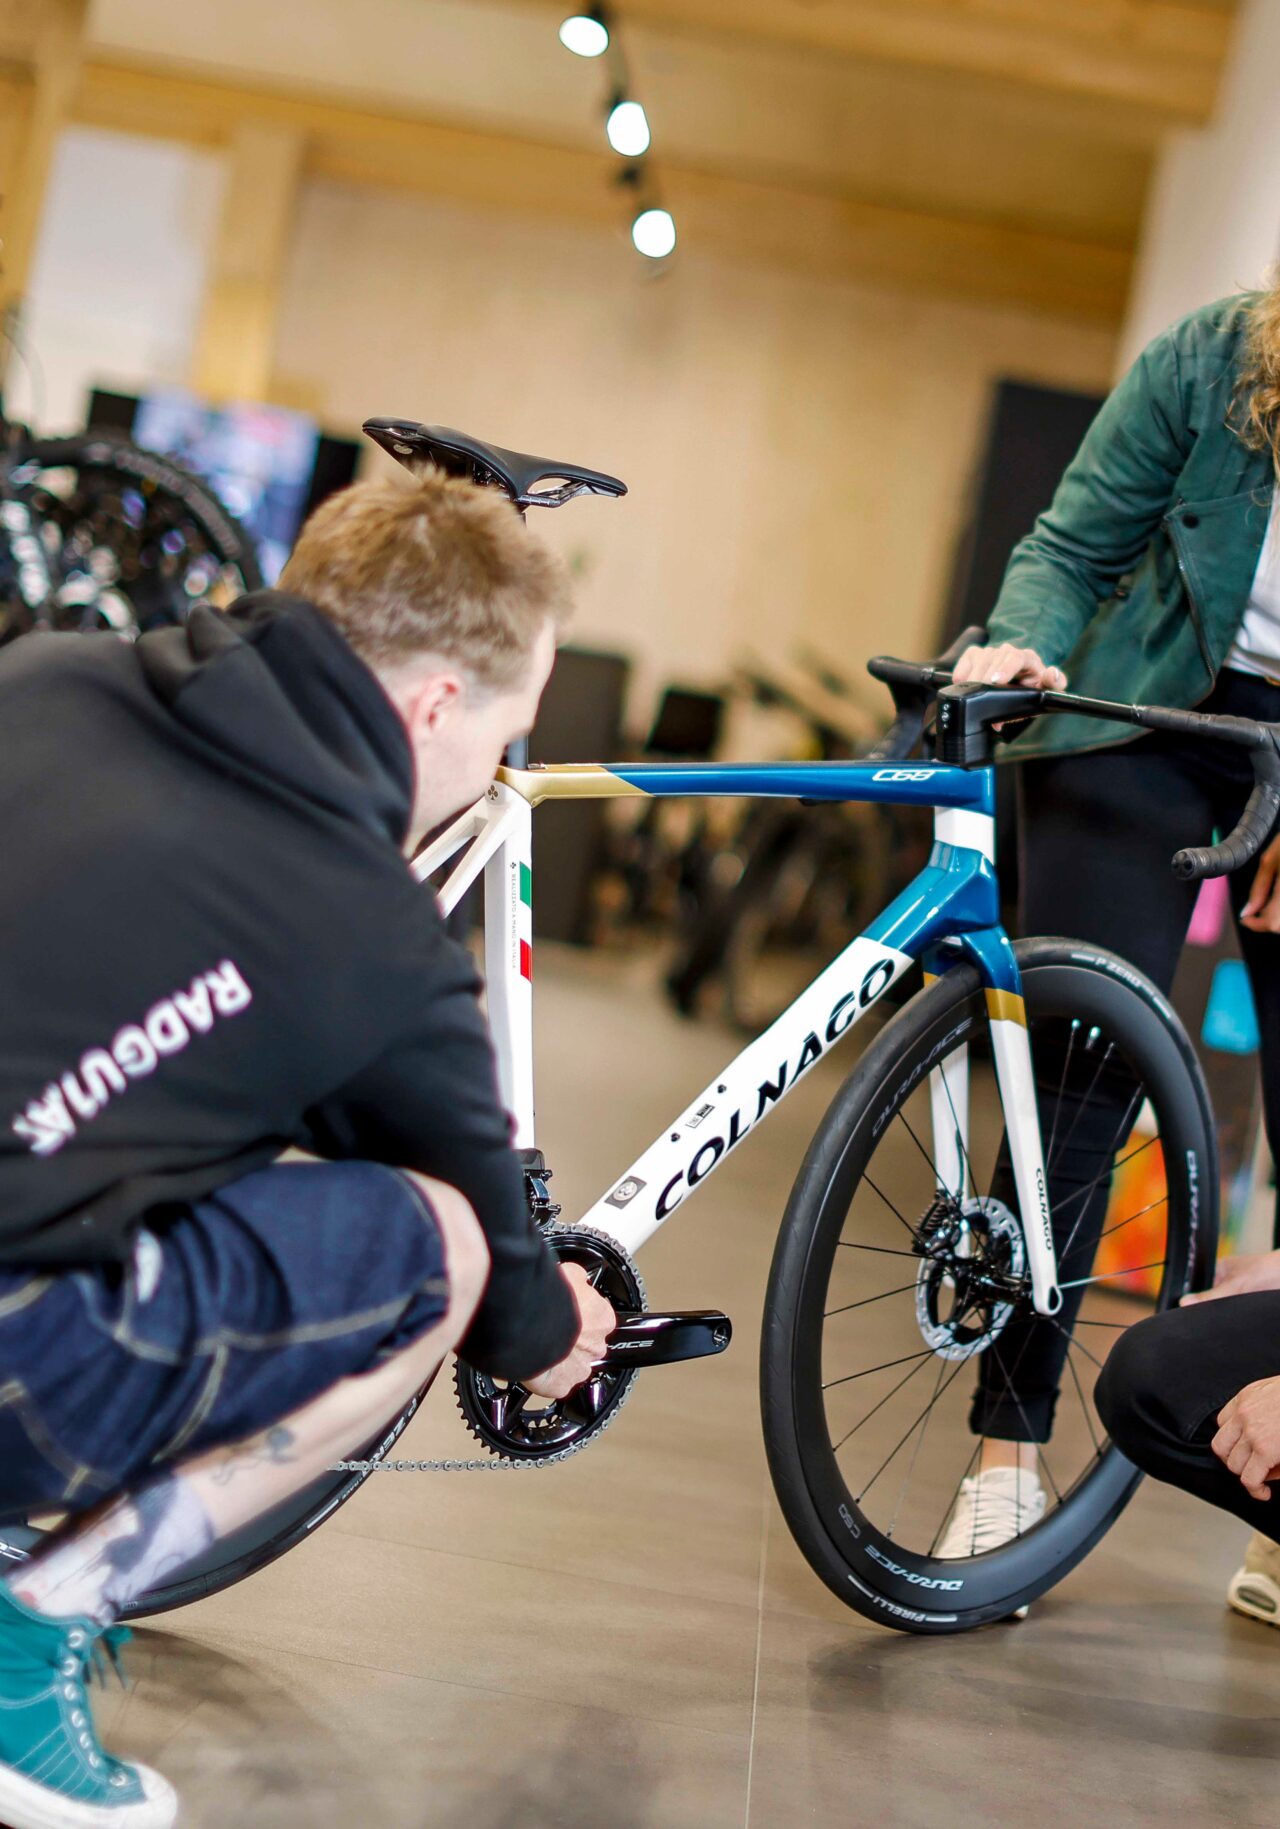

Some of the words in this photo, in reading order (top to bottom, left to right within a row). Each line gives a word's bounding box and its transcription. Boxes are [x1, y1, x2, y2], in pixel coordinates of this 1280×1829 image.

[872, 769, 952, 782] C68
[655, 957, 896, 1222] COLNAGO
[1035, 1167, 1053, 1252] COLNAGO
[864, 1544, 964, 1591] DURA-ACE
[872, 1596, 927, 1623] PIRELLI
